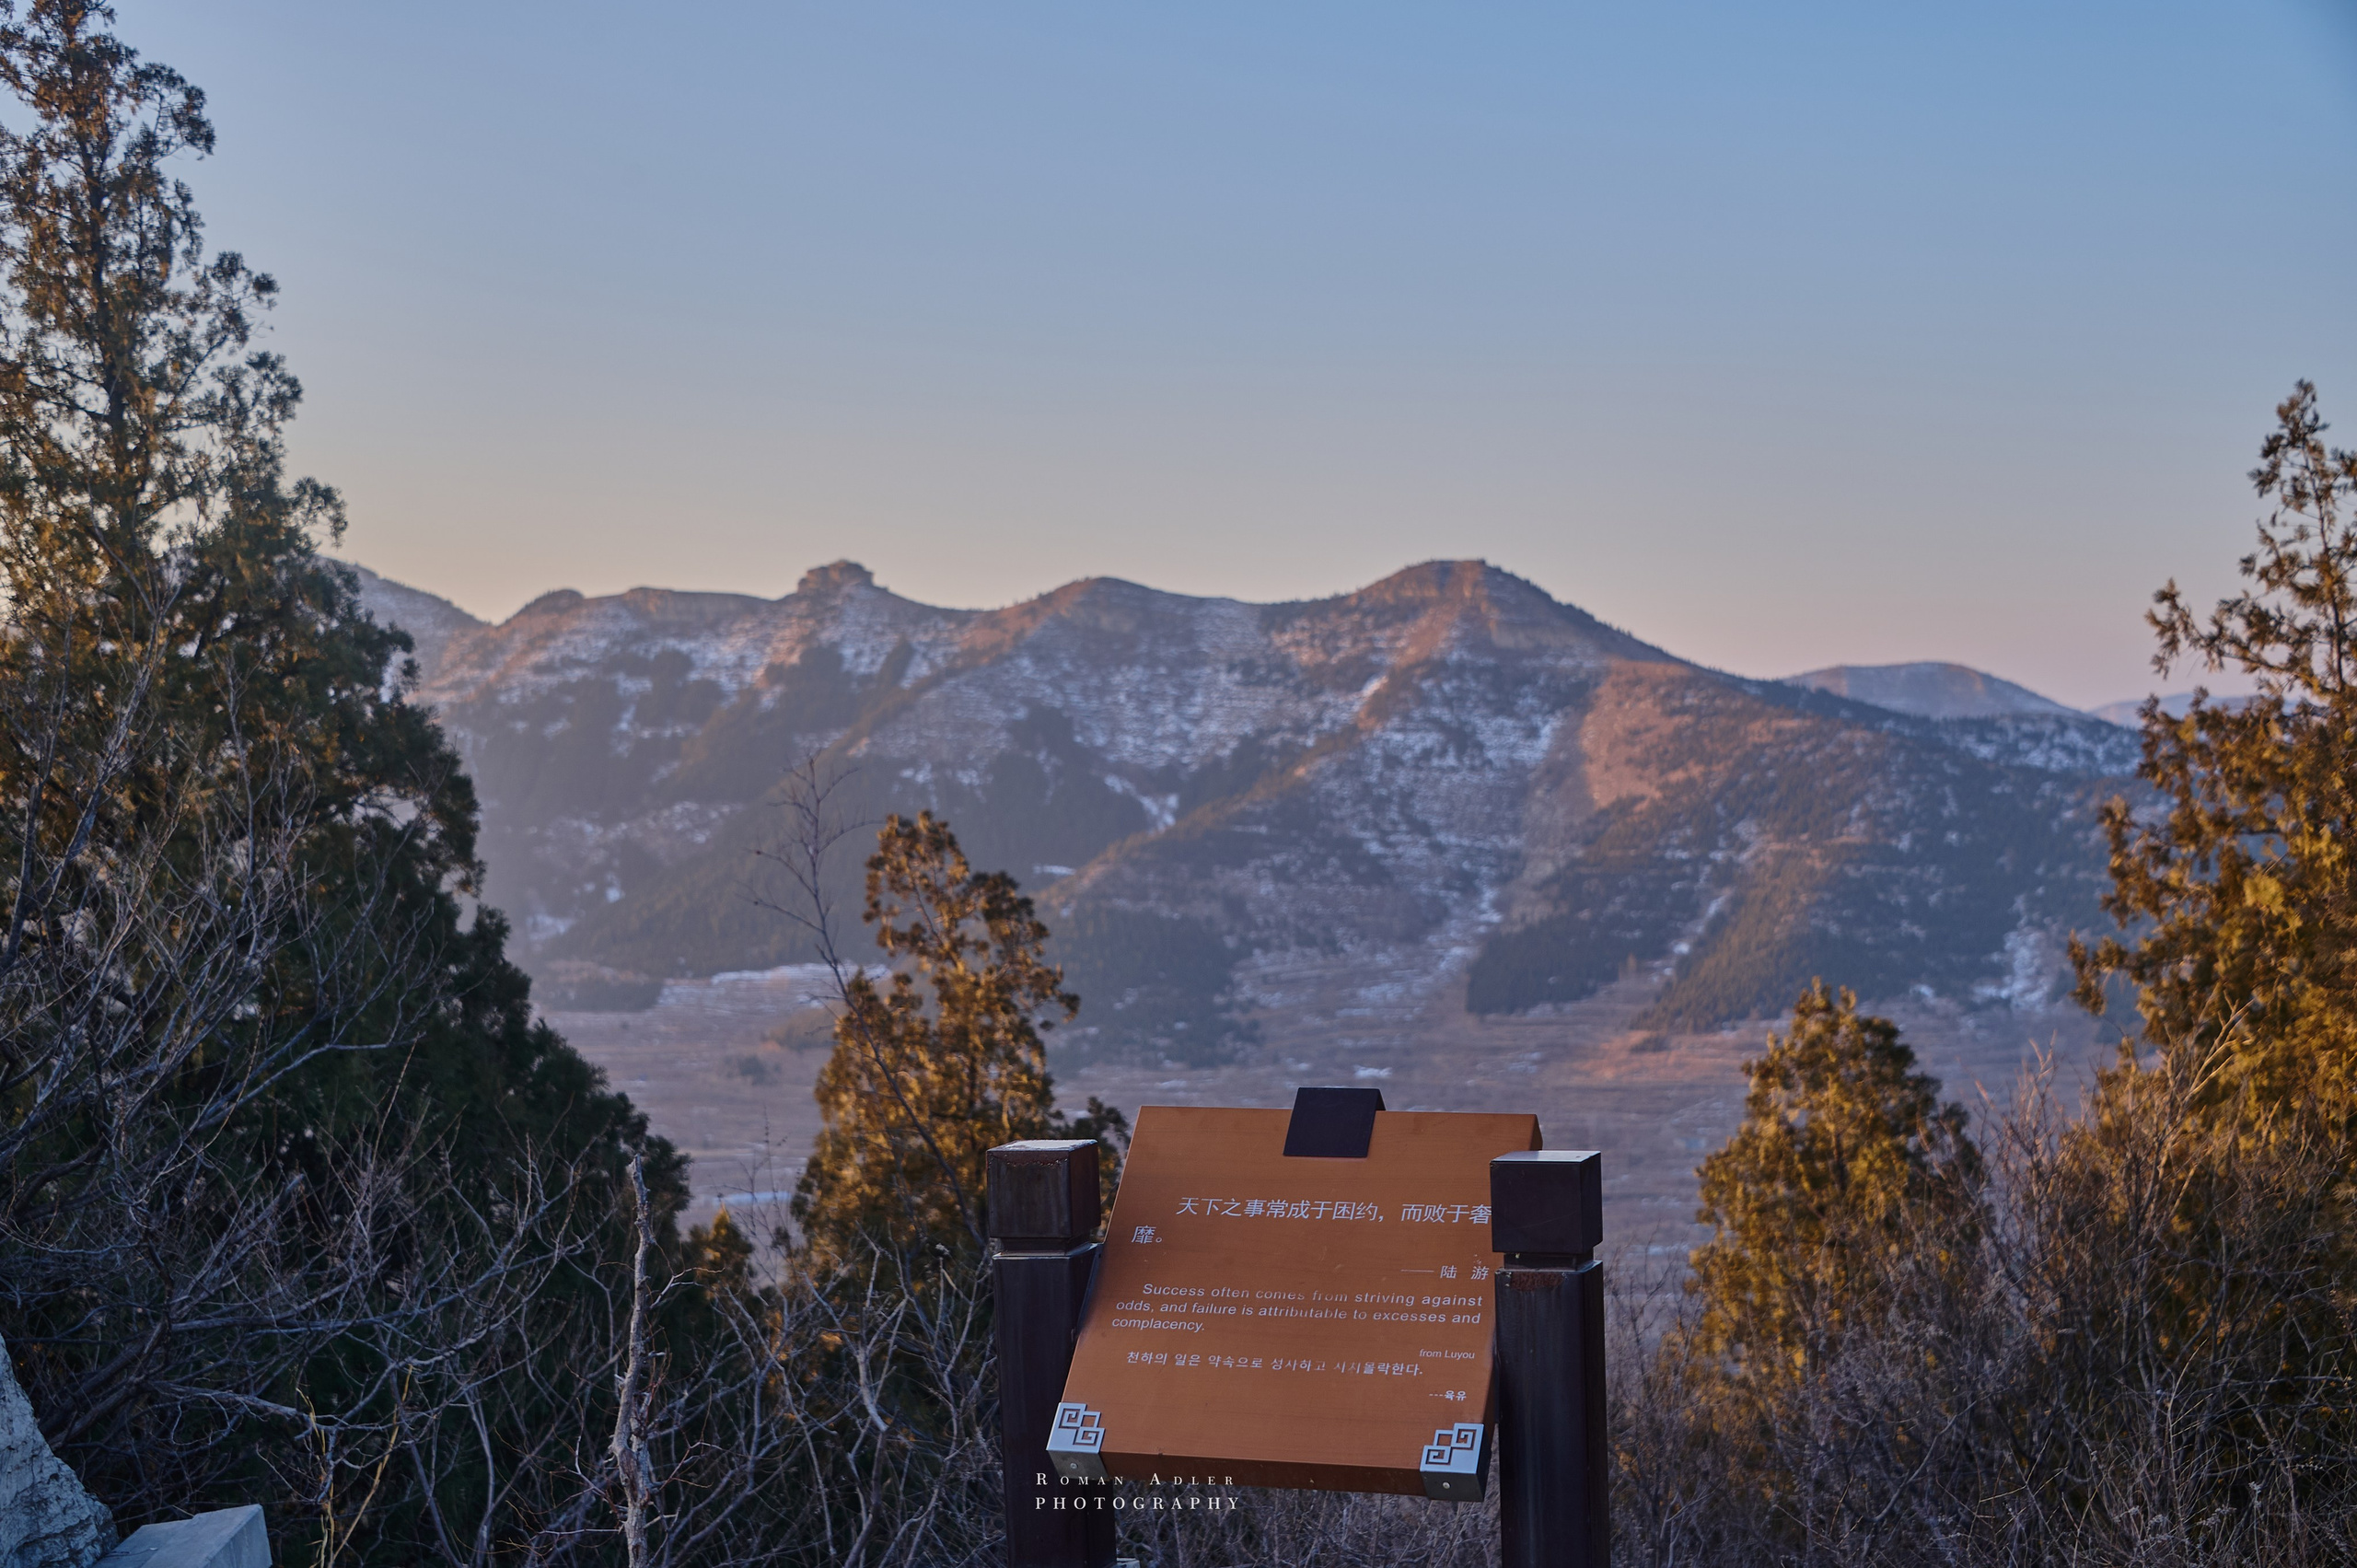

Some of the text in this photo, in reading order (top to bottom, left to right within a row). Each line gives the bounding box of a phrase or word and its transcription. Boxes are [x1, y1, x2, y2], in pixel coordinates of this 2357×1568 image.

[1142, 1283, 1483, 1309] Success often comes from striving against
[1115, 1299, 1481, 1324] odds, and failure is attributable to excesses and
[1111, 1318, 1206, 1333] complacency.
[1126, 1351, 1168, 1365] 천하의
[1174, 1353, 1202, 1367] 일은
[1207, 1354, 1263, 1369] 약속으로
[1271, 1357, 1327, 1373] 성사하고
[1419, 1348, 1476, 1361] from Luyou
